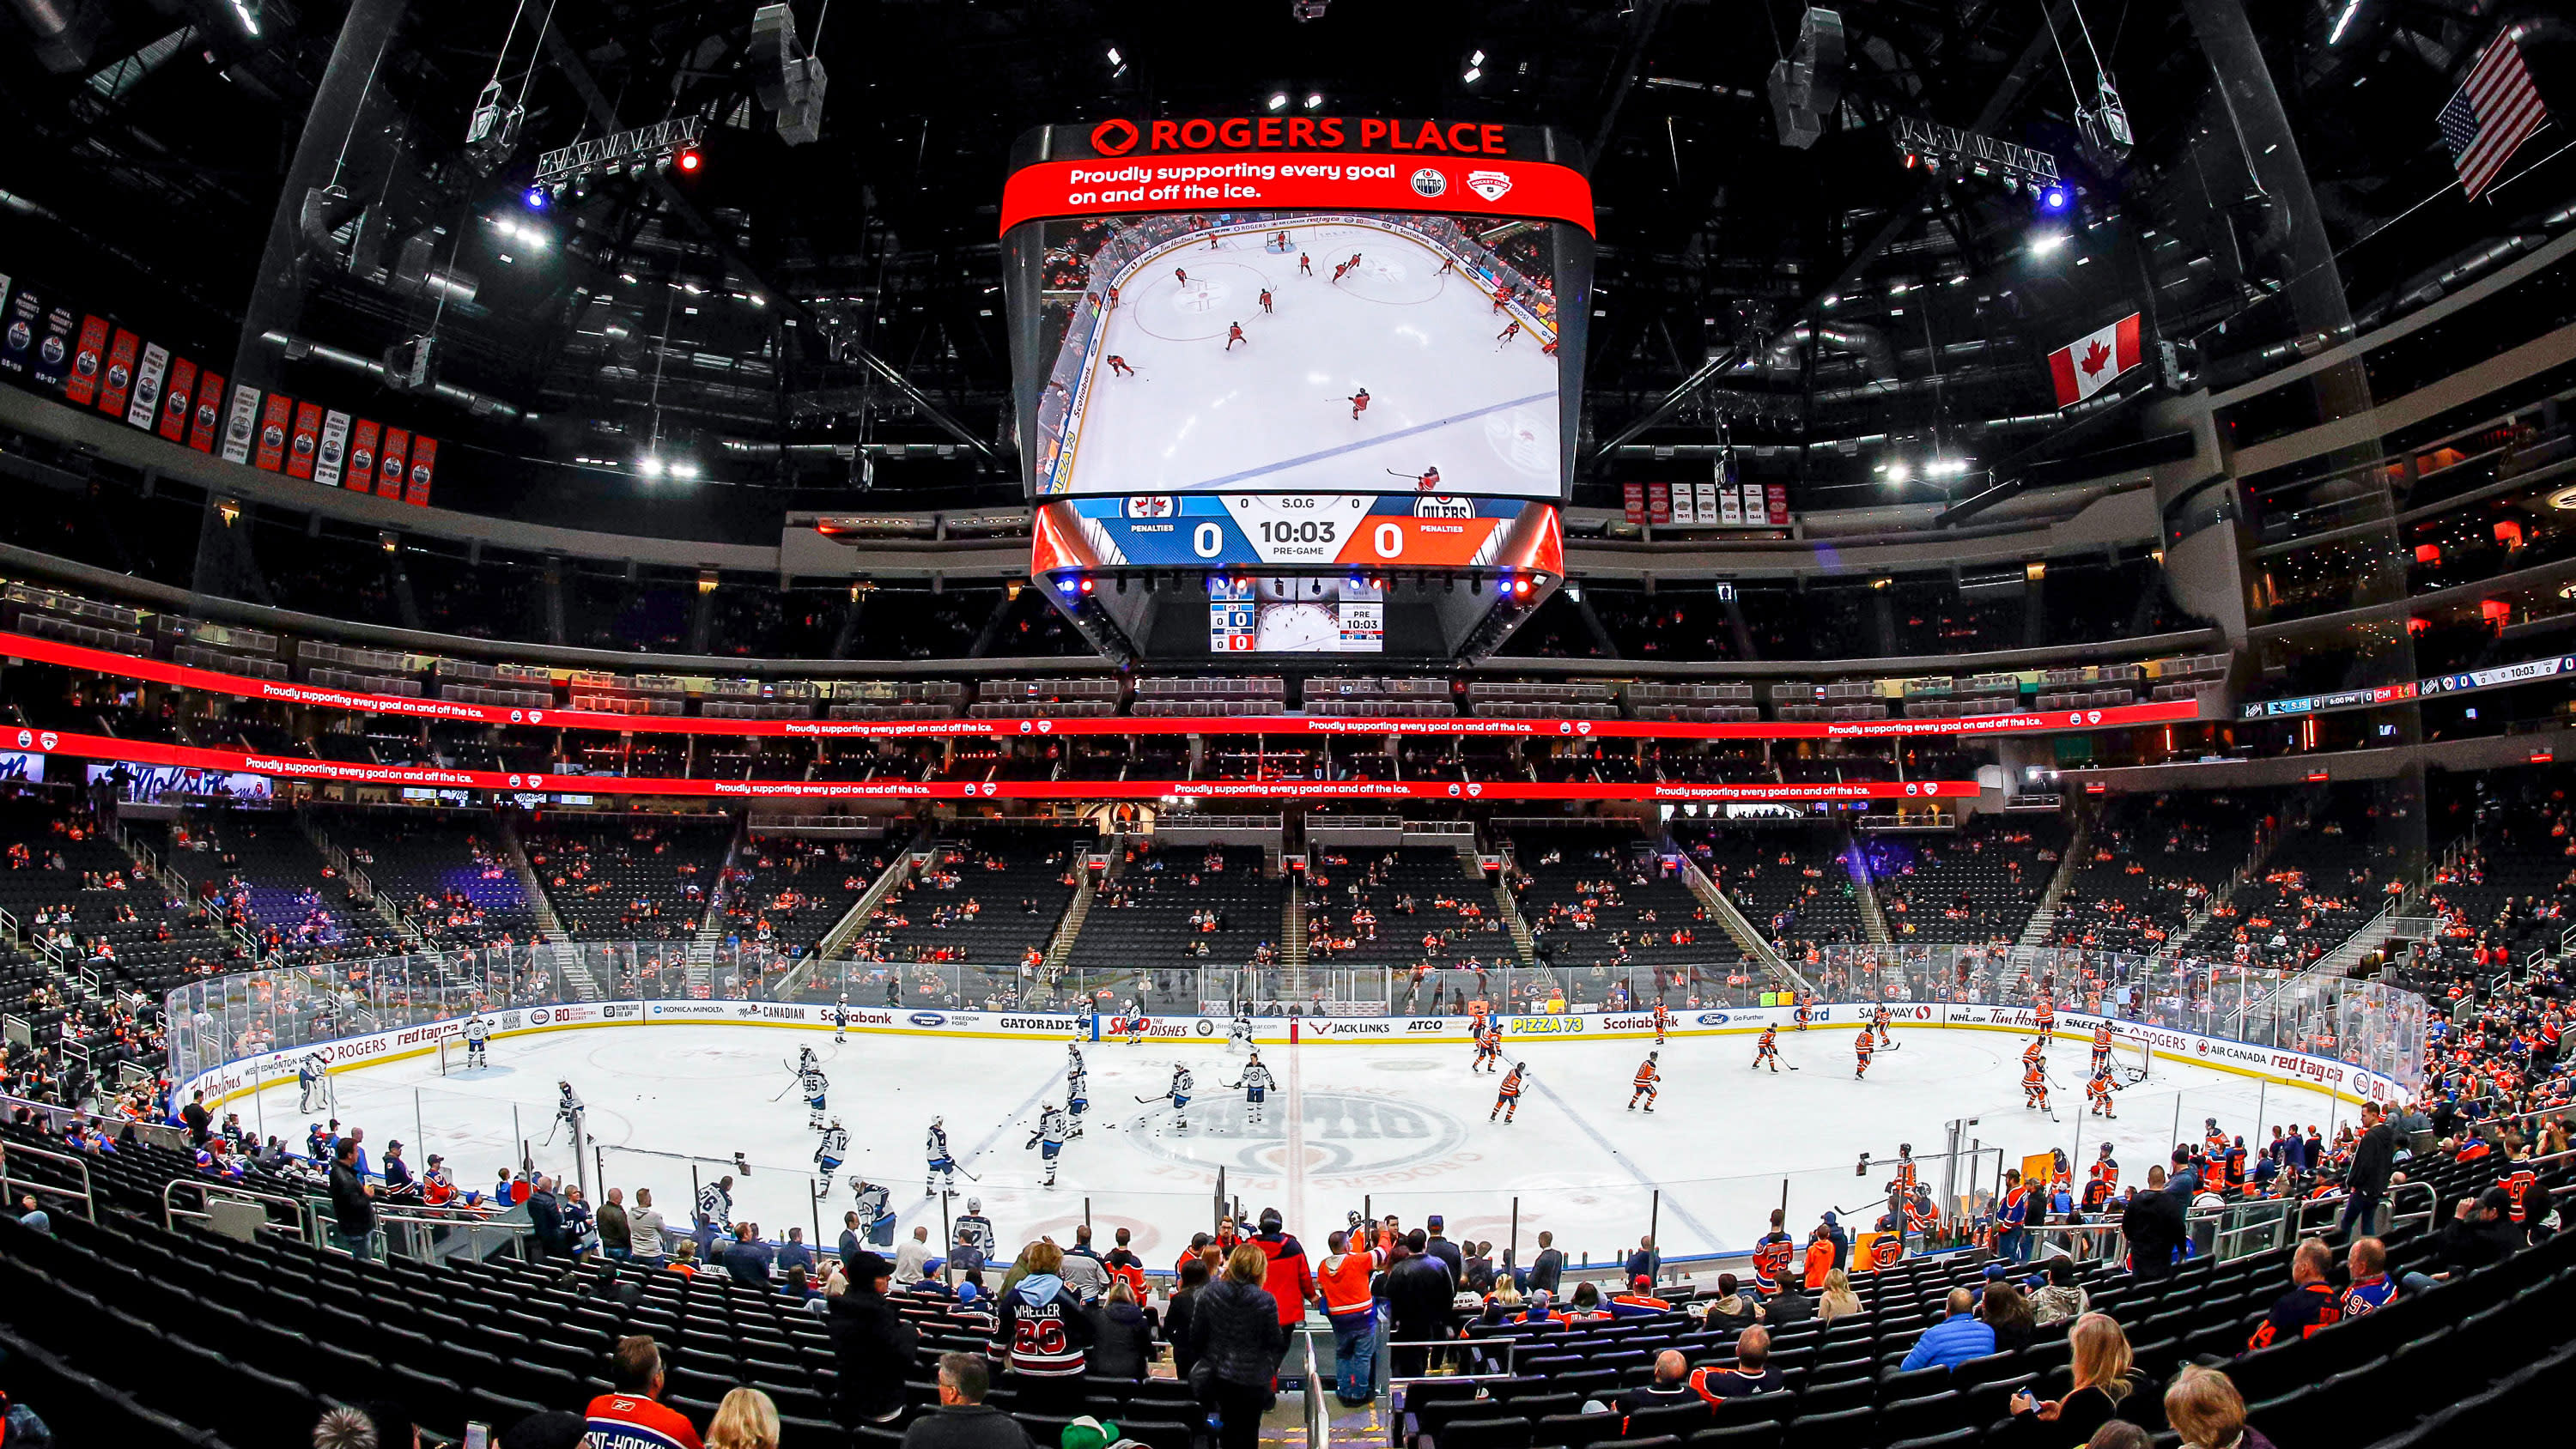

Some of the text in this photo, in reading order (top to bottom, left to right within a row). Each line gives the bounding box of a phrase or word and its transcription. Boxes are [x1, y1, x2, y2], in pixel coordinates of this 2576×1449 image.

[1151, 118, 1507, 155] ROGERS PLACE
[1071, 162, 1395, 185] Proudly supporting every goal
[1069, 183, 1261, 204] on and off the ice.
[1416, 179, 1442, 194] OILERS
[1240, 499, 1360, 508] 0 S.O.G 0
[1261, 521, 1335, 543] 10:03
[1420, 524, 1463, 533] PENALTIES
[1194, 522, 1223, 558] 0
[1374, 522, 1403, 558] 0
[1235, 612, 1248, 626] 0
[1347, 621, 1377, 629] 10:03
[1235, 635, 1248, 650] 0
[2460, 658, 2573, 687] 0 10:03 0
[264, 684, 300, 700] Proudly
[302, 690, 351, 706] supporting
[353, 697, 377, 709] every
[380, 700, 401, 712] goal
[417, 703, 435, 713] and
[437, 704, 451, 715] off
[452, 706, 466, 717] the
[468, 706, 483, 718] ice.
[2291, 700, 2307, 710] SJS
[2314, 699, 2319, 707] 0
[2366, 692, 2372, 700] 0
[2377, 689, 2391, 700] CHI
[786, 724, 820, 733] Proudly
[822, 724, 869, 734] supporting
[871, 725, 895, 734] every
[896, 724, 914, 734] goal
[978, 724, 993, 732] ice.
[1309, 721, 1346, 731] Proudly
[1347, 721, 1398, 732] supporting
[1400, 724, 1426, 732] every
[1428, 722, 1449, 733] goal
[1466, 723, 1484, 731] and
[1485, 723, 1499, 731] off
[1501, 723, 1515, 731] the
[1516, 723, 1533, 731] ice.
[1829, 725, 1862, 736] Proudly
[1865, 723, 1912, 734] supporting
[1915, 724, 1939, 733] every
[1941, 722, 1961, 733] goal
[1977, 719, 1994, 729] and
[1996, 718, 2010, 728] off
[2011, 718, 2025, 727] the
[2026, 717, 2043, 726] ice.
[246, 757, 473, 784] Proudly supporting every goal on and off the ice.
[715, 783, 750, 793] Proudly
[752, 784, 801, 794] supporting
[830, 785, 851, 795] goal
[1175, 785, 1212, 795] Proudly
[1215, 785, 1267, 795] supporting
[1270, 785, 1297, 795] every
[1299, 784, 1321, 795] goal
[1339, 785, 1357, 793] and
[1359, 785, 1374, 793] off
[1376, 785, 1391, 793] the
[1393, 785, 1410, 794] ice.
[1656, 786, 1690, 797] Proudly
[1691, 787, 1739, 797] supporting
[1741, 788, 1765, 797] every
[1767, 787, 1789, 797] goal
[1803, 787, 1822, 796] and
[1824, 787, 1837, 796] off
[1838, 787, 1852, 796] the
[1854, 787, 1870, 796] ice.
[555, 1009, 569, 1022] 80
[693, 1005, 724, 1014] MINOLTA
[763, 1007, 805, 1020] CANADIAN
[1990, 1009, 2012, 1025] Tim
[1000, 1018, 1072, 1030] GATORADE
[1407, 1020, 1443, 1030] ATCO
[1511, 1017, 1584, 1034] PIZZA 73
[1703, 1015, 1724, 1024] Ford
[1150, 1025, 1188, 1037] DISHES
[1332, 1022, 1358, 1034] JACK
[338, 1039, 386, 1059] ROGERS
[2210, 1046, 2267, 1064] AIR CANADA
[261, 1059, 298, 1072] EDMONTON
[2372, 1081, 2385, 1101] 80
[836, 1136, 848, 1151] 12
[1766, 1254, 1790, 1272] 29
[1880, 1249, 1895, 1262] 97
[2348, 1295, 2373, 1316] 97
